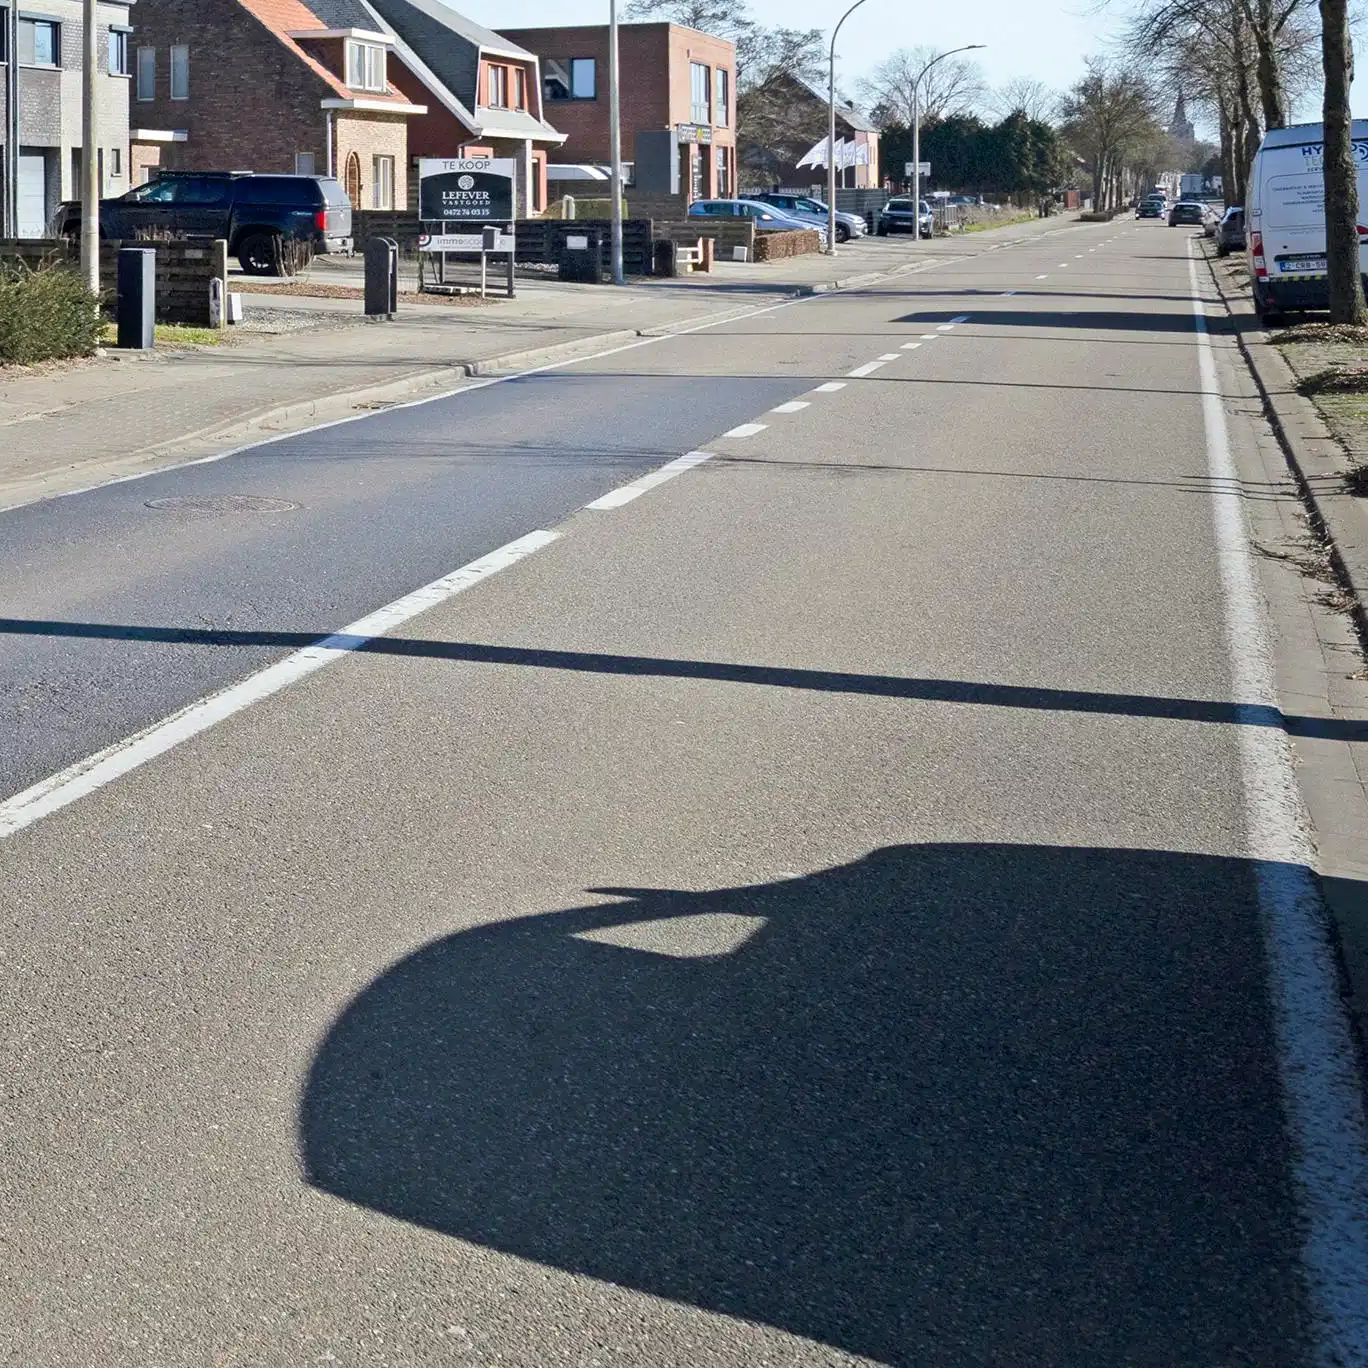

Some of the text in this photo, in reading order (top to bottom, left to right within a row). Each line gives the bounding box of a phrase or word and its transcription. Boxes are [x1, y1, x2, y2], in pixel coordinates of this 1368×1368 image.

[443, 161, 490, 170] TE KOOP
[442, 191, 490, 200] LEFEVER
